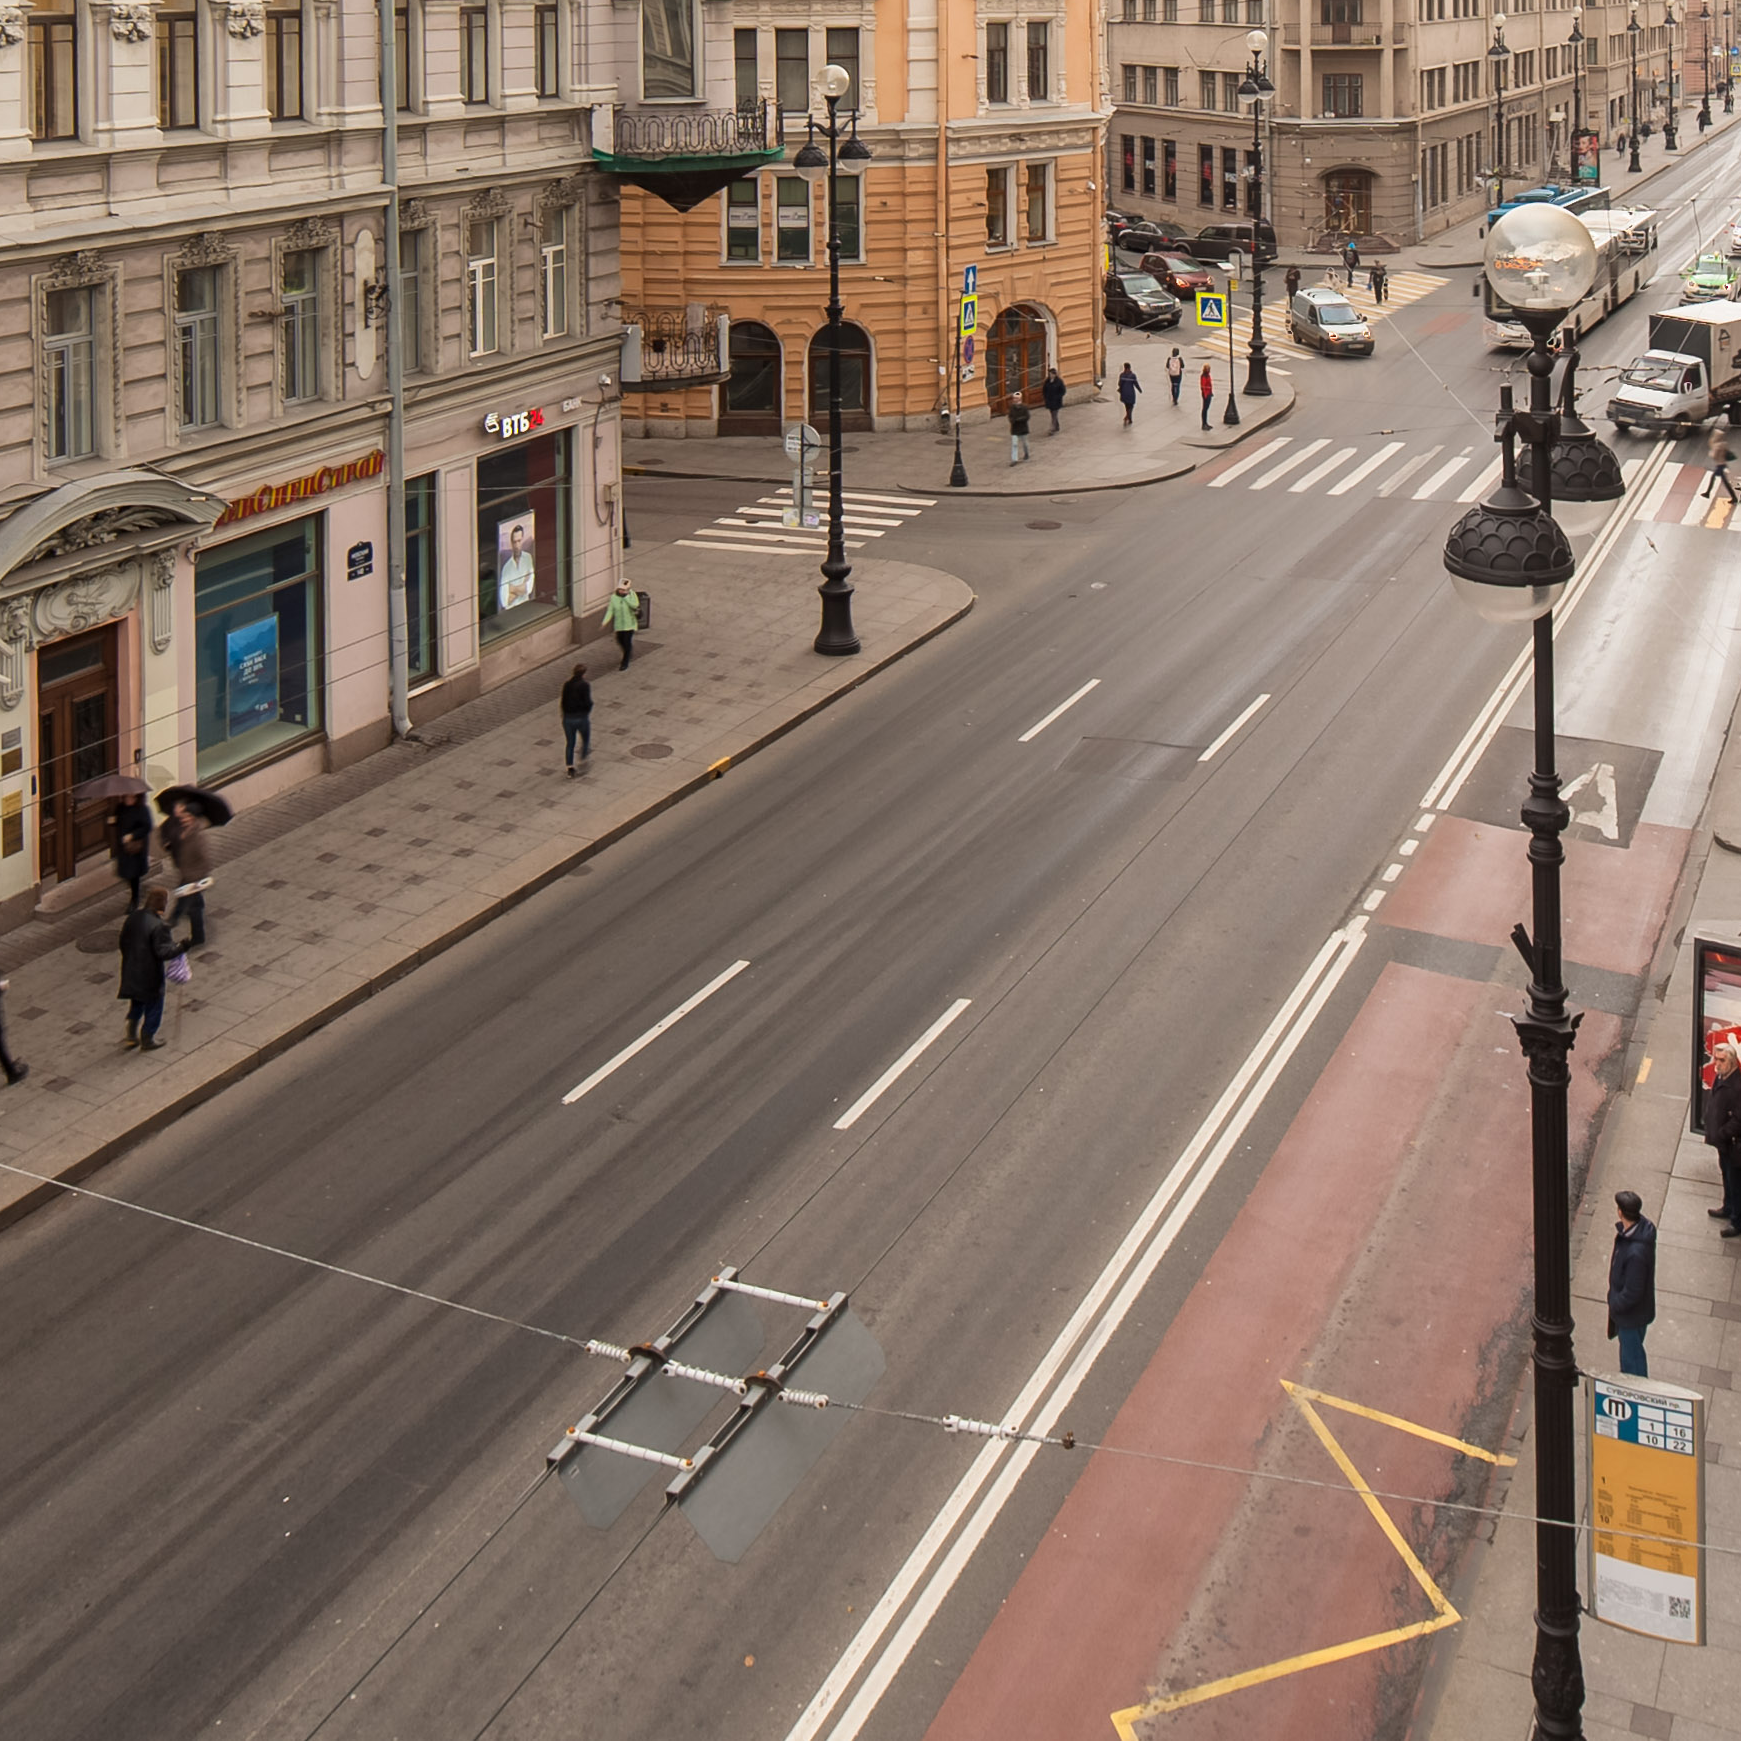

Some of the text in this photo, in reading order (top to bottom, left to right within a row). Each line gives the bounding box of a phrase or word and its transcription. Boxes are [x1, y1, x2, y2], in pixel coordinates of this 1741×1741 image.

[502, 408, 546, 438] ВТБ24
[1606, 1386, 1667, 1406] СУВОРОВСКИЙ
[1650, 1422, 1686, 1438] 1 16
[1645, 1434, 1686, 1452] 10 22
[1600, 1515, 1610, 1524] 10
